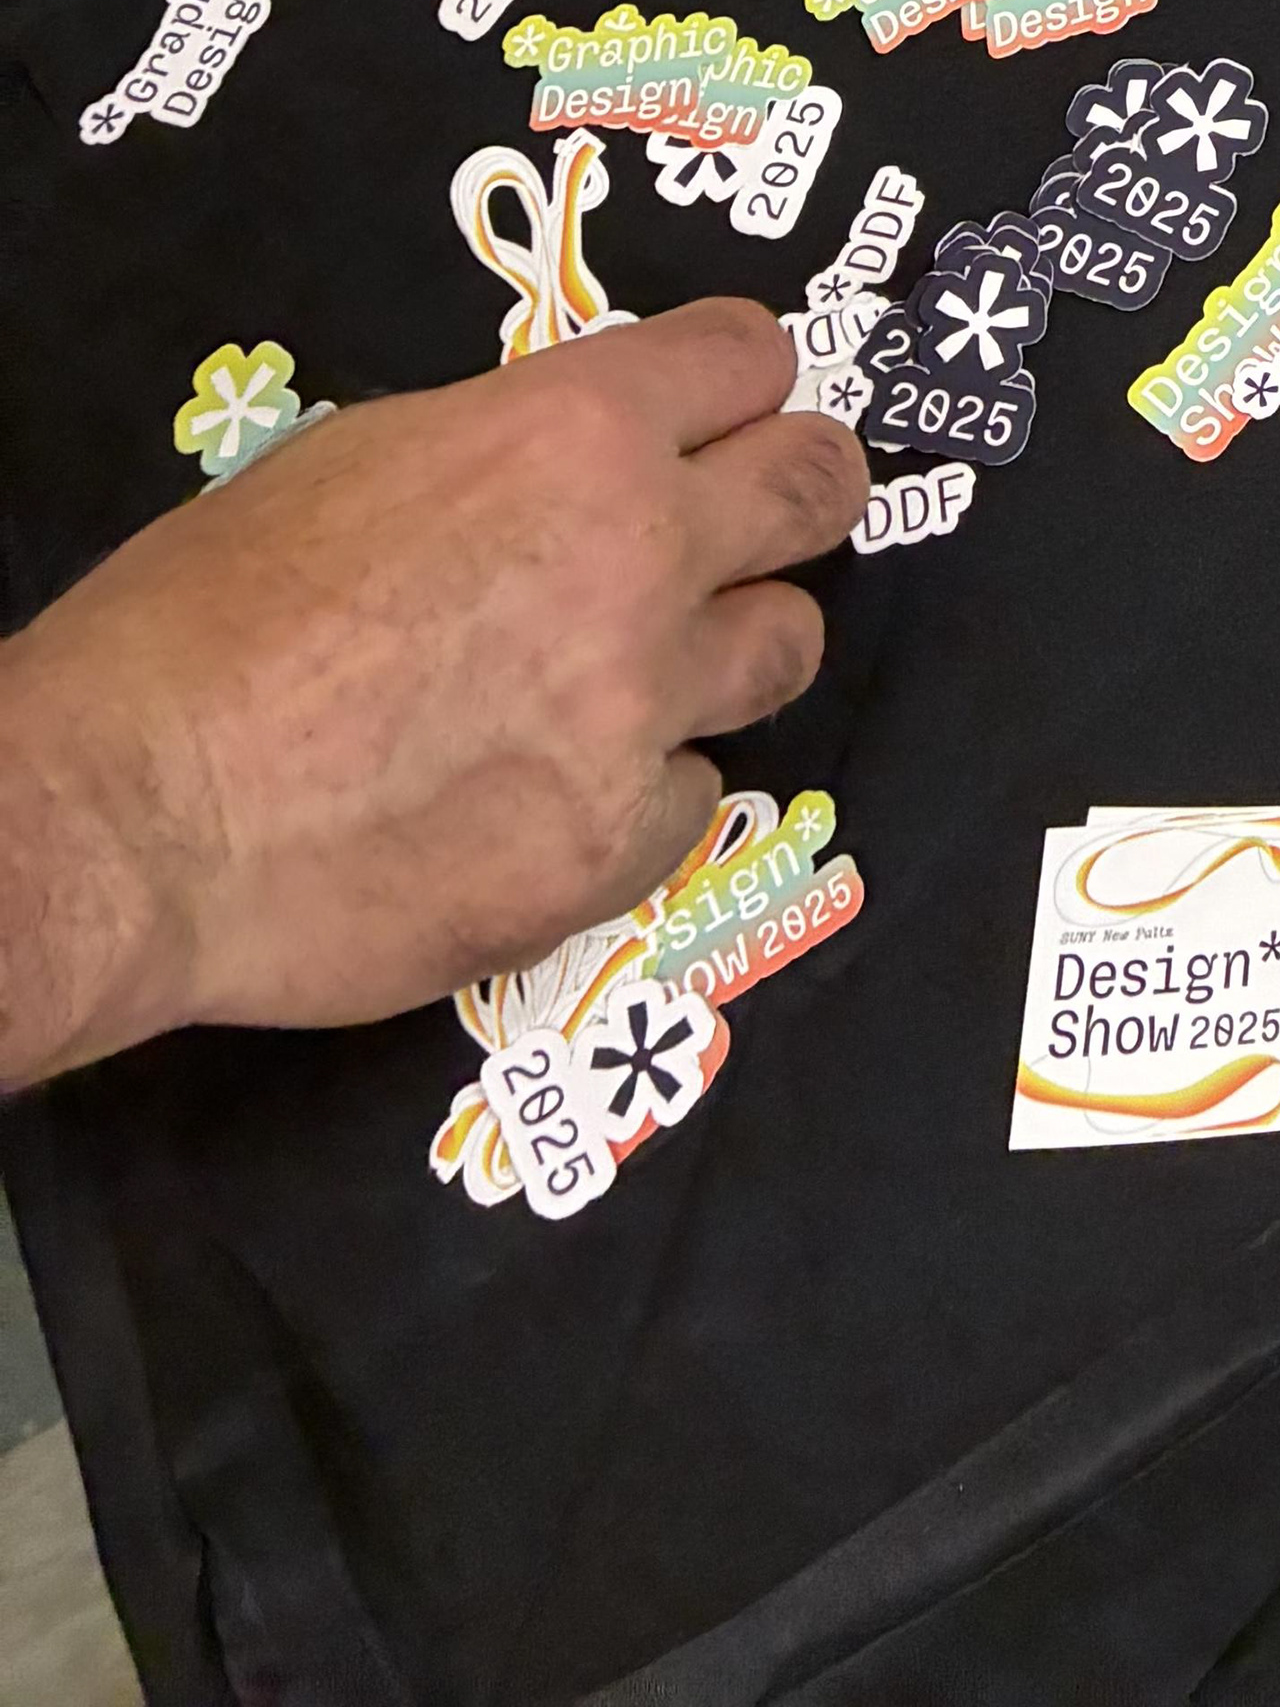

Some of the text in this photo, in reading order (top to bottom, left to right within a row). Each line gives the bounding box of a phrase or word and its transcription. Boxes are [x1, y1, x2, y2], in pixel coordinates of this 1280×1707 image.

[537, 74, 692, 122] Design
[746, 100, 826, 221] 2025
[1093, 162, 1220, 248] 2025
[881, 380, 1019, 448] 2025
[756, 871, 853, 959] 2025
[1047, 1003, 1180, 1060] Show
[501, 1048, 596, 1197] 2025
